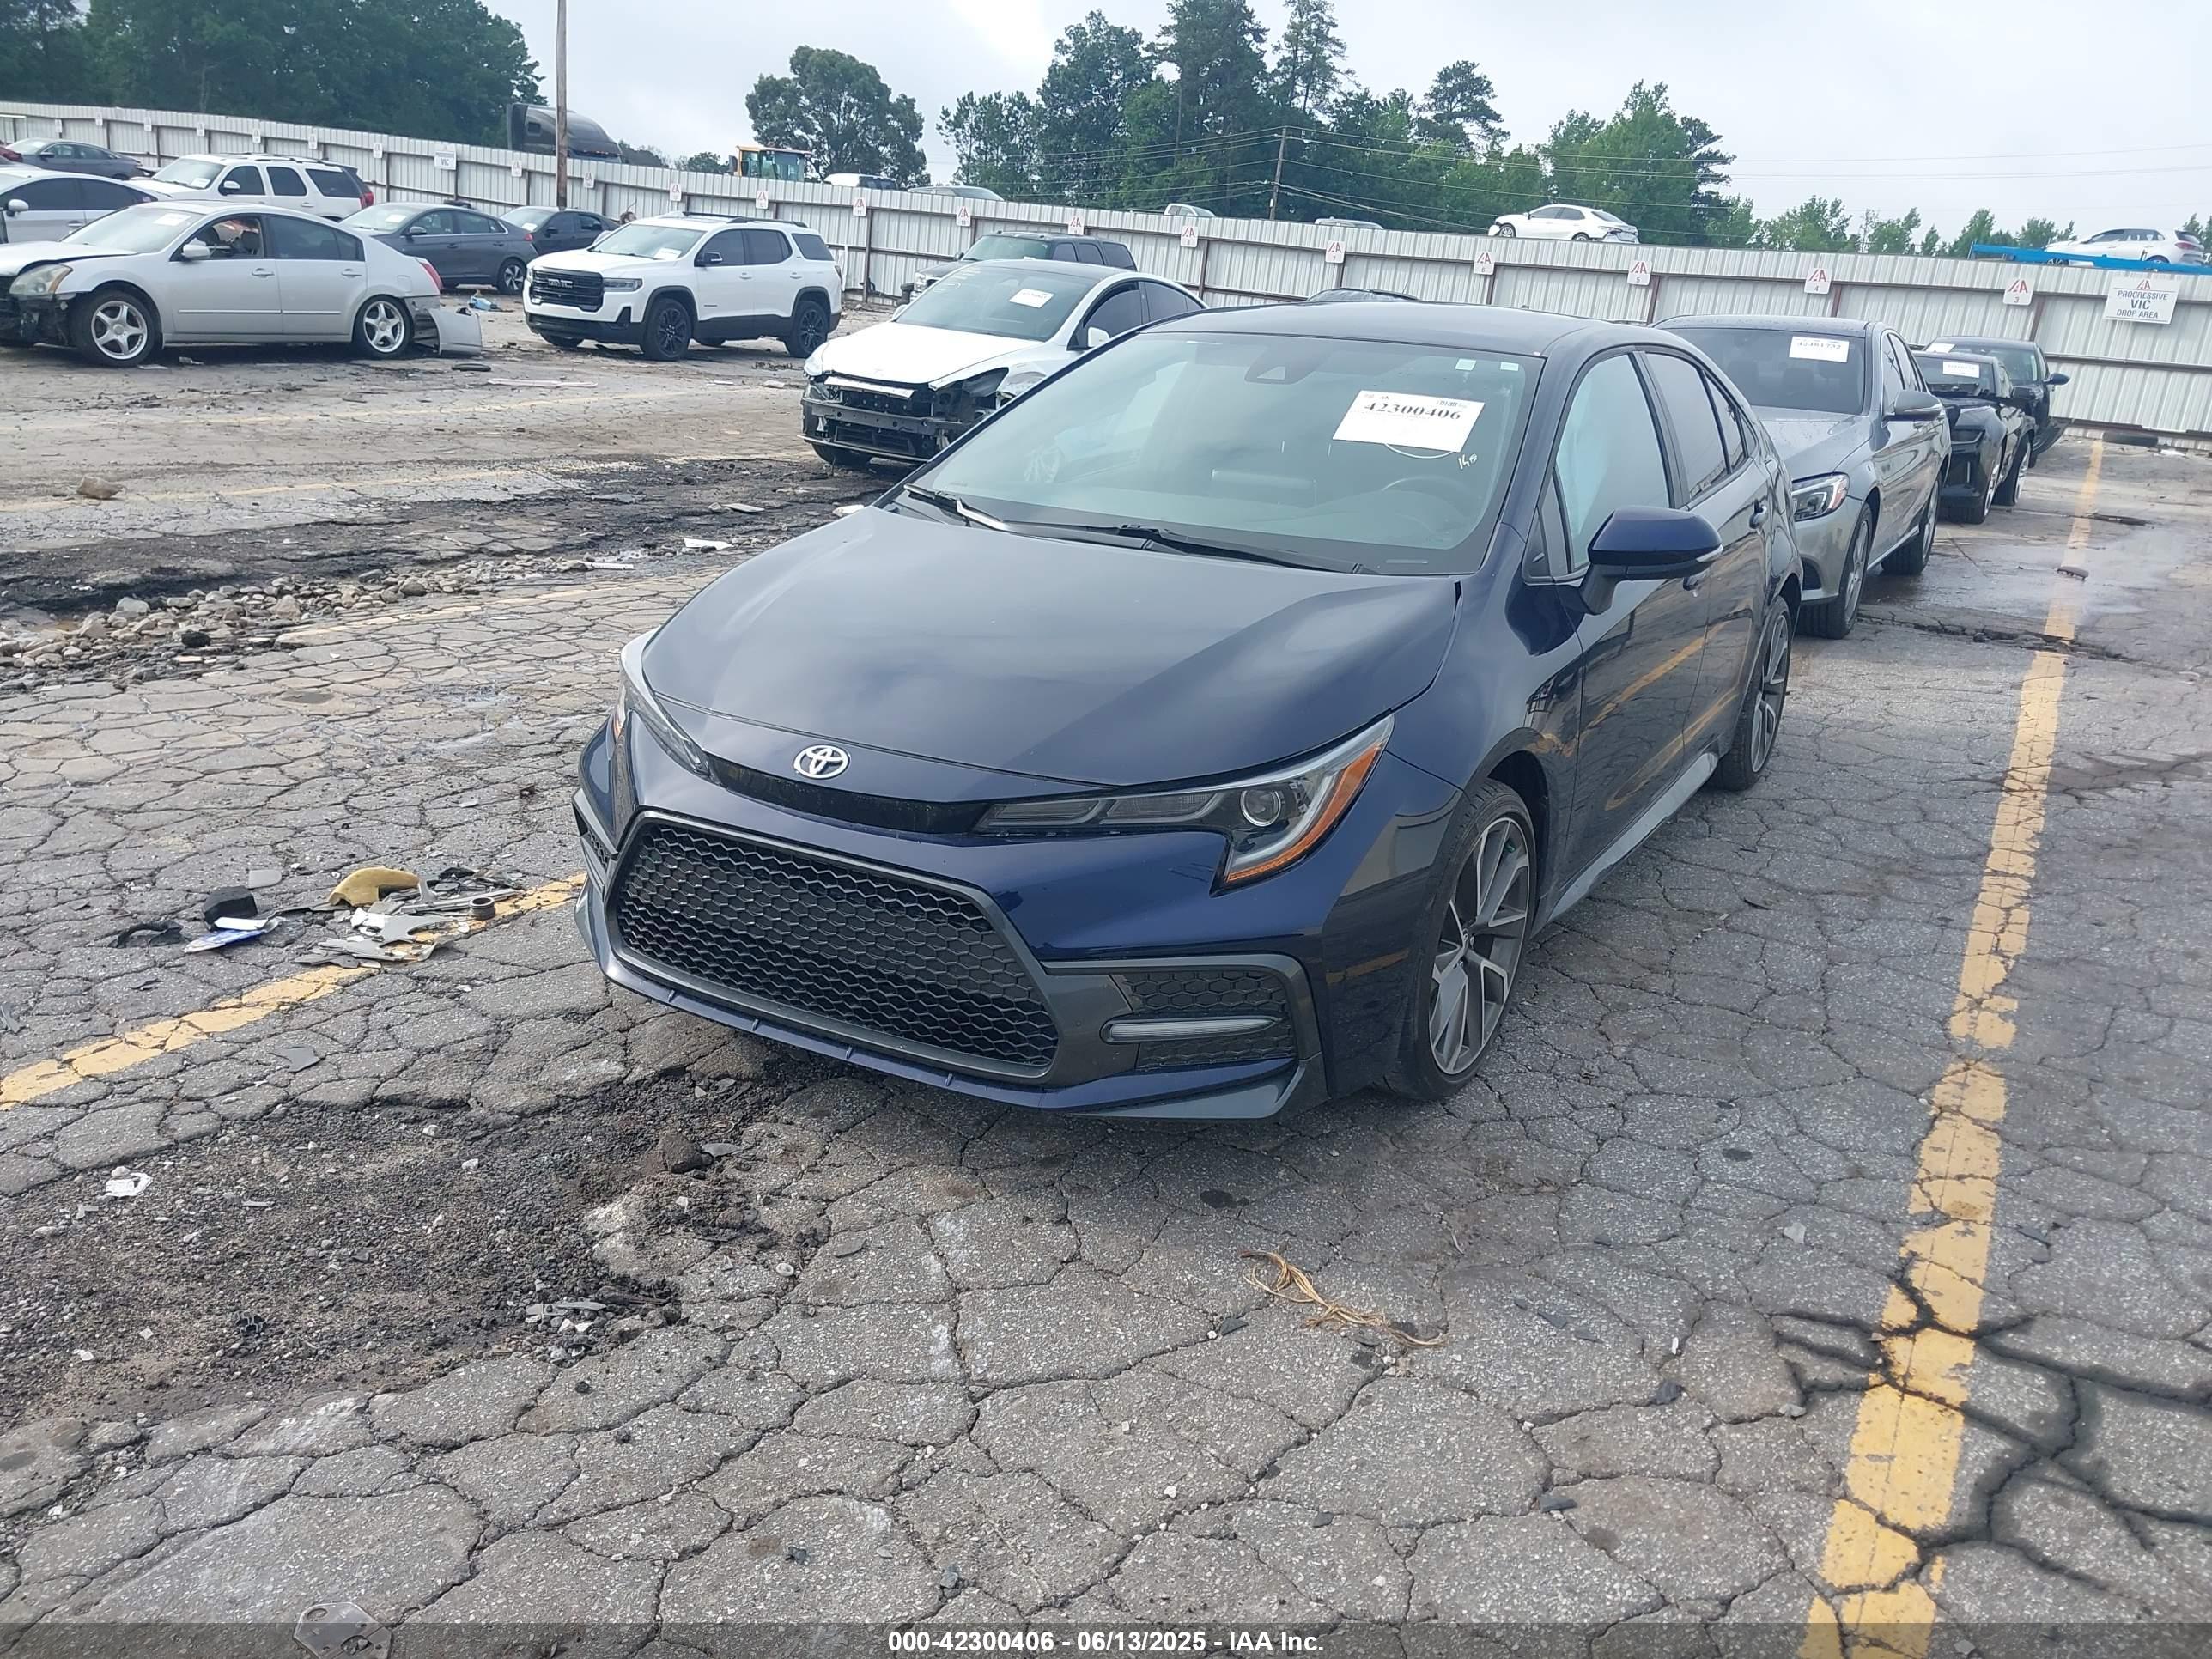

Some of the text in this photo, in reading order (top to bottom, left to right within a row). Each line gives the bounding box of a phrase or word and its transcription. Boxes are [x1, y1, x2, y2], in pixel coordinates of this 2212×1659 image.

[2118, 290, 2169, 301] PROGRESSIVE
[2130, 299, 2151, 310] VIC
[1364, 402, 1462, 420] 42300406
